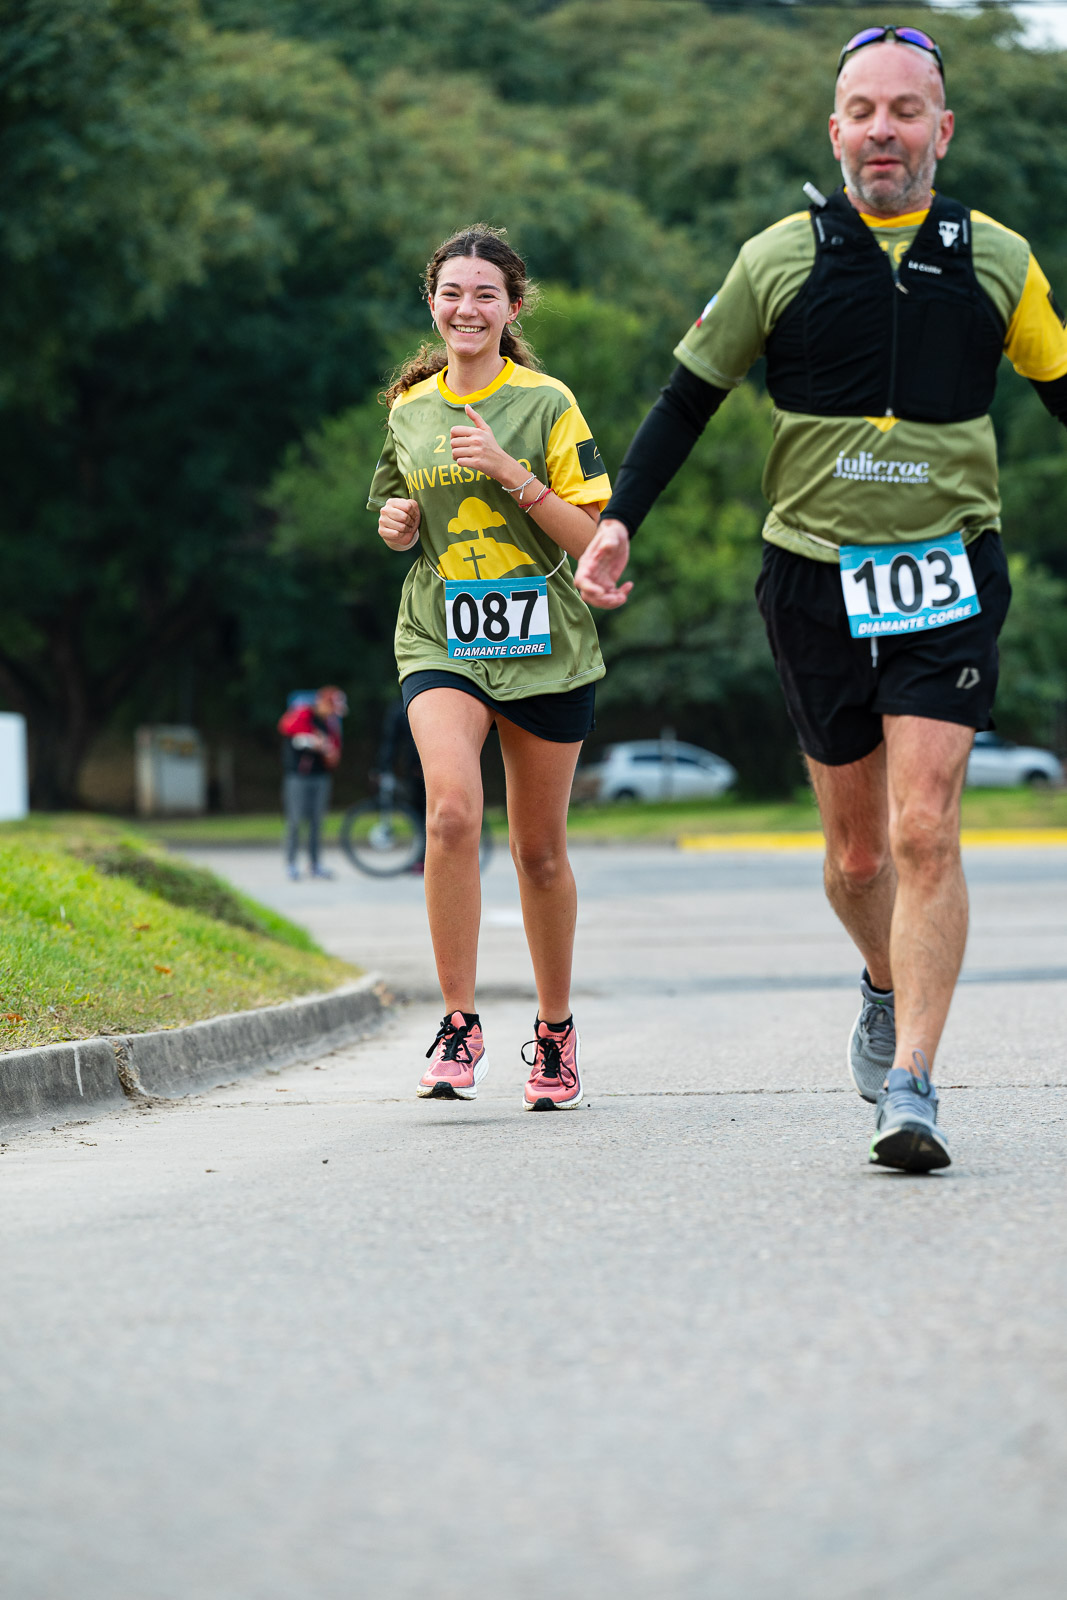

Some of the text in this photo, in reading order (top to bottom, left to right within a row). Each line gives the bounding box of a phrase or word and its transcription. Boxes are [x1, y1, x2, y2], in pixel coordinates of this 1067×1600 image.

[833, 450, 930, 477] julicroc
[852, 548, 961, 618] 103
[452, 589, 539, 644] 087
[857, 604, 973, 635] DIAMANTE CORRE
[453, 643, 546, 657] DIAMANTE CORRE
